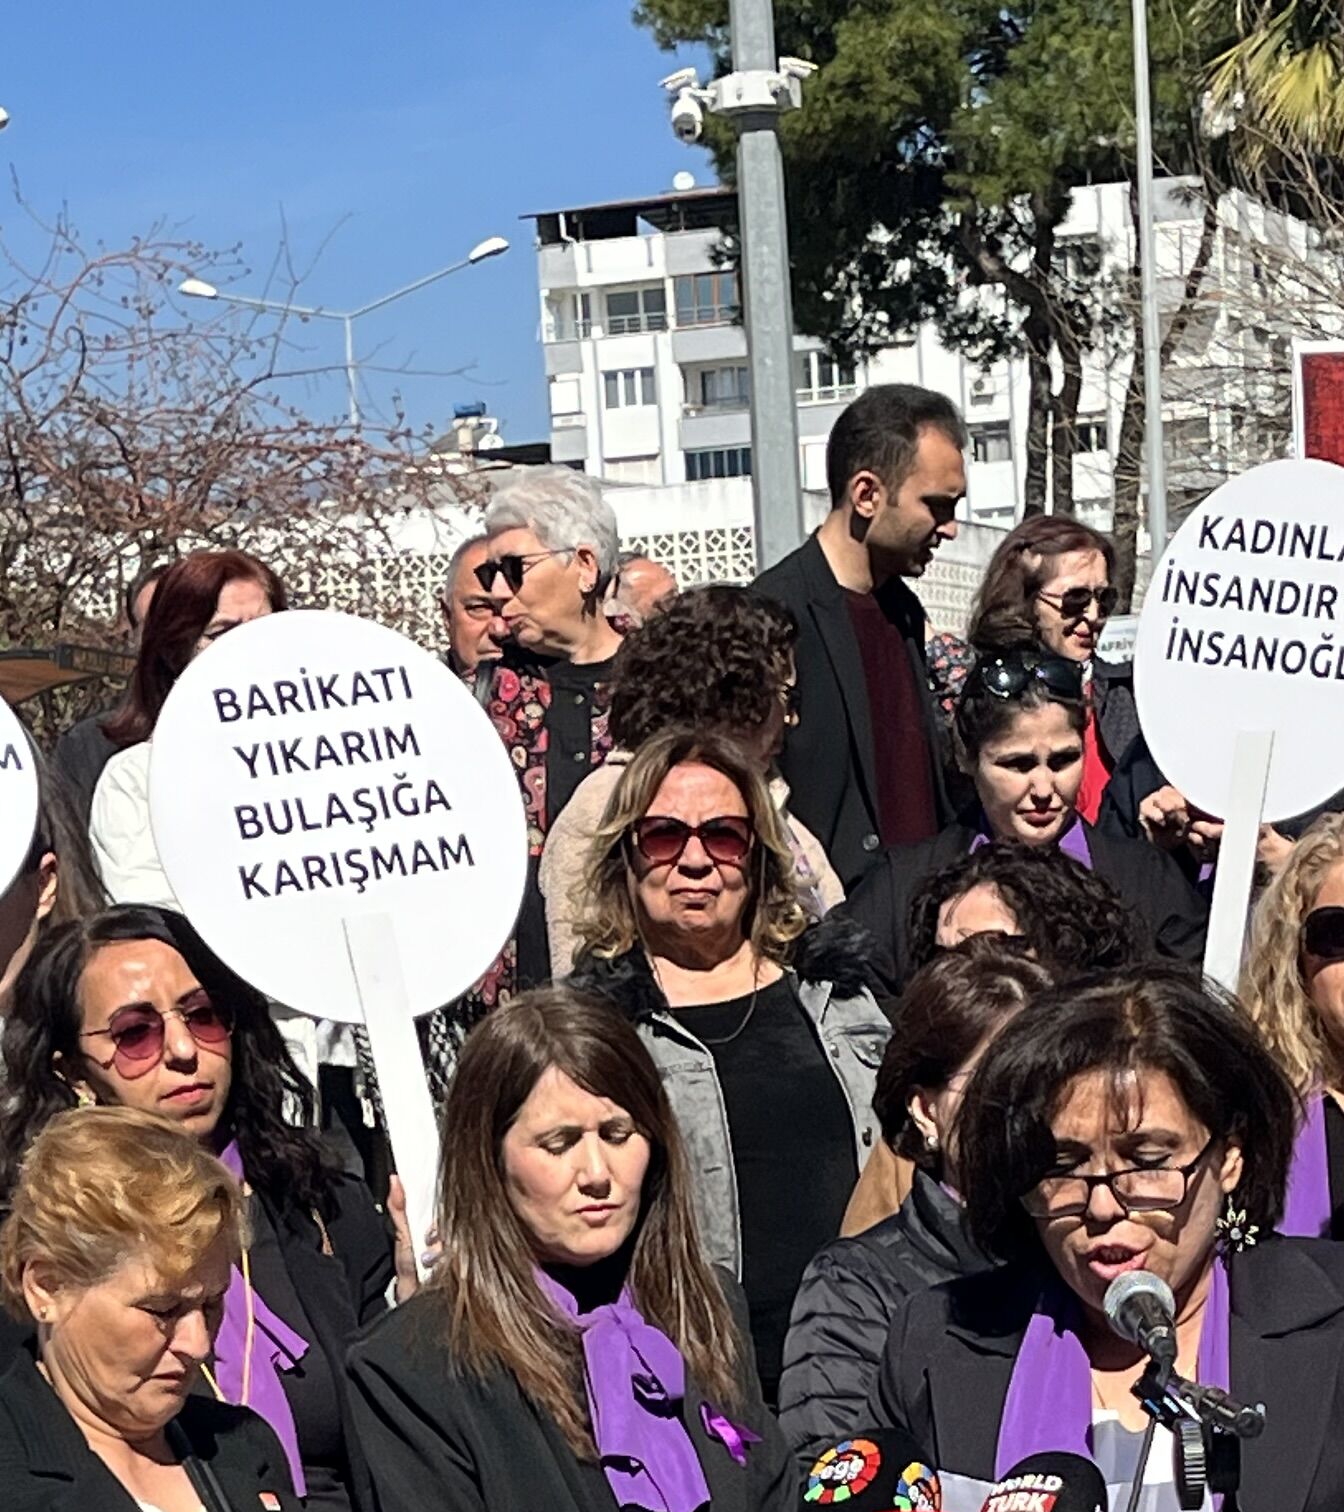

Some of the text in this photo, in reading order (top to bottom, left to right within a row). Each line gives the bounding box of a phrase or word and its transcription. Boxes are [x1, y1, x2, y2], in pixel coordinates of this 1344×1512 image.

[1162, 558, 1339, 620] İNSANDIR
[212, 666, 412, 723] BARİKATI
[233, 724, 421, 779] YIKARIM
[234, 779, 452, 840] BULAŞIĞA
[238, 833, 475, 900] KARIŞMAM
[989, 1473, 1063, 1497] WORLD
